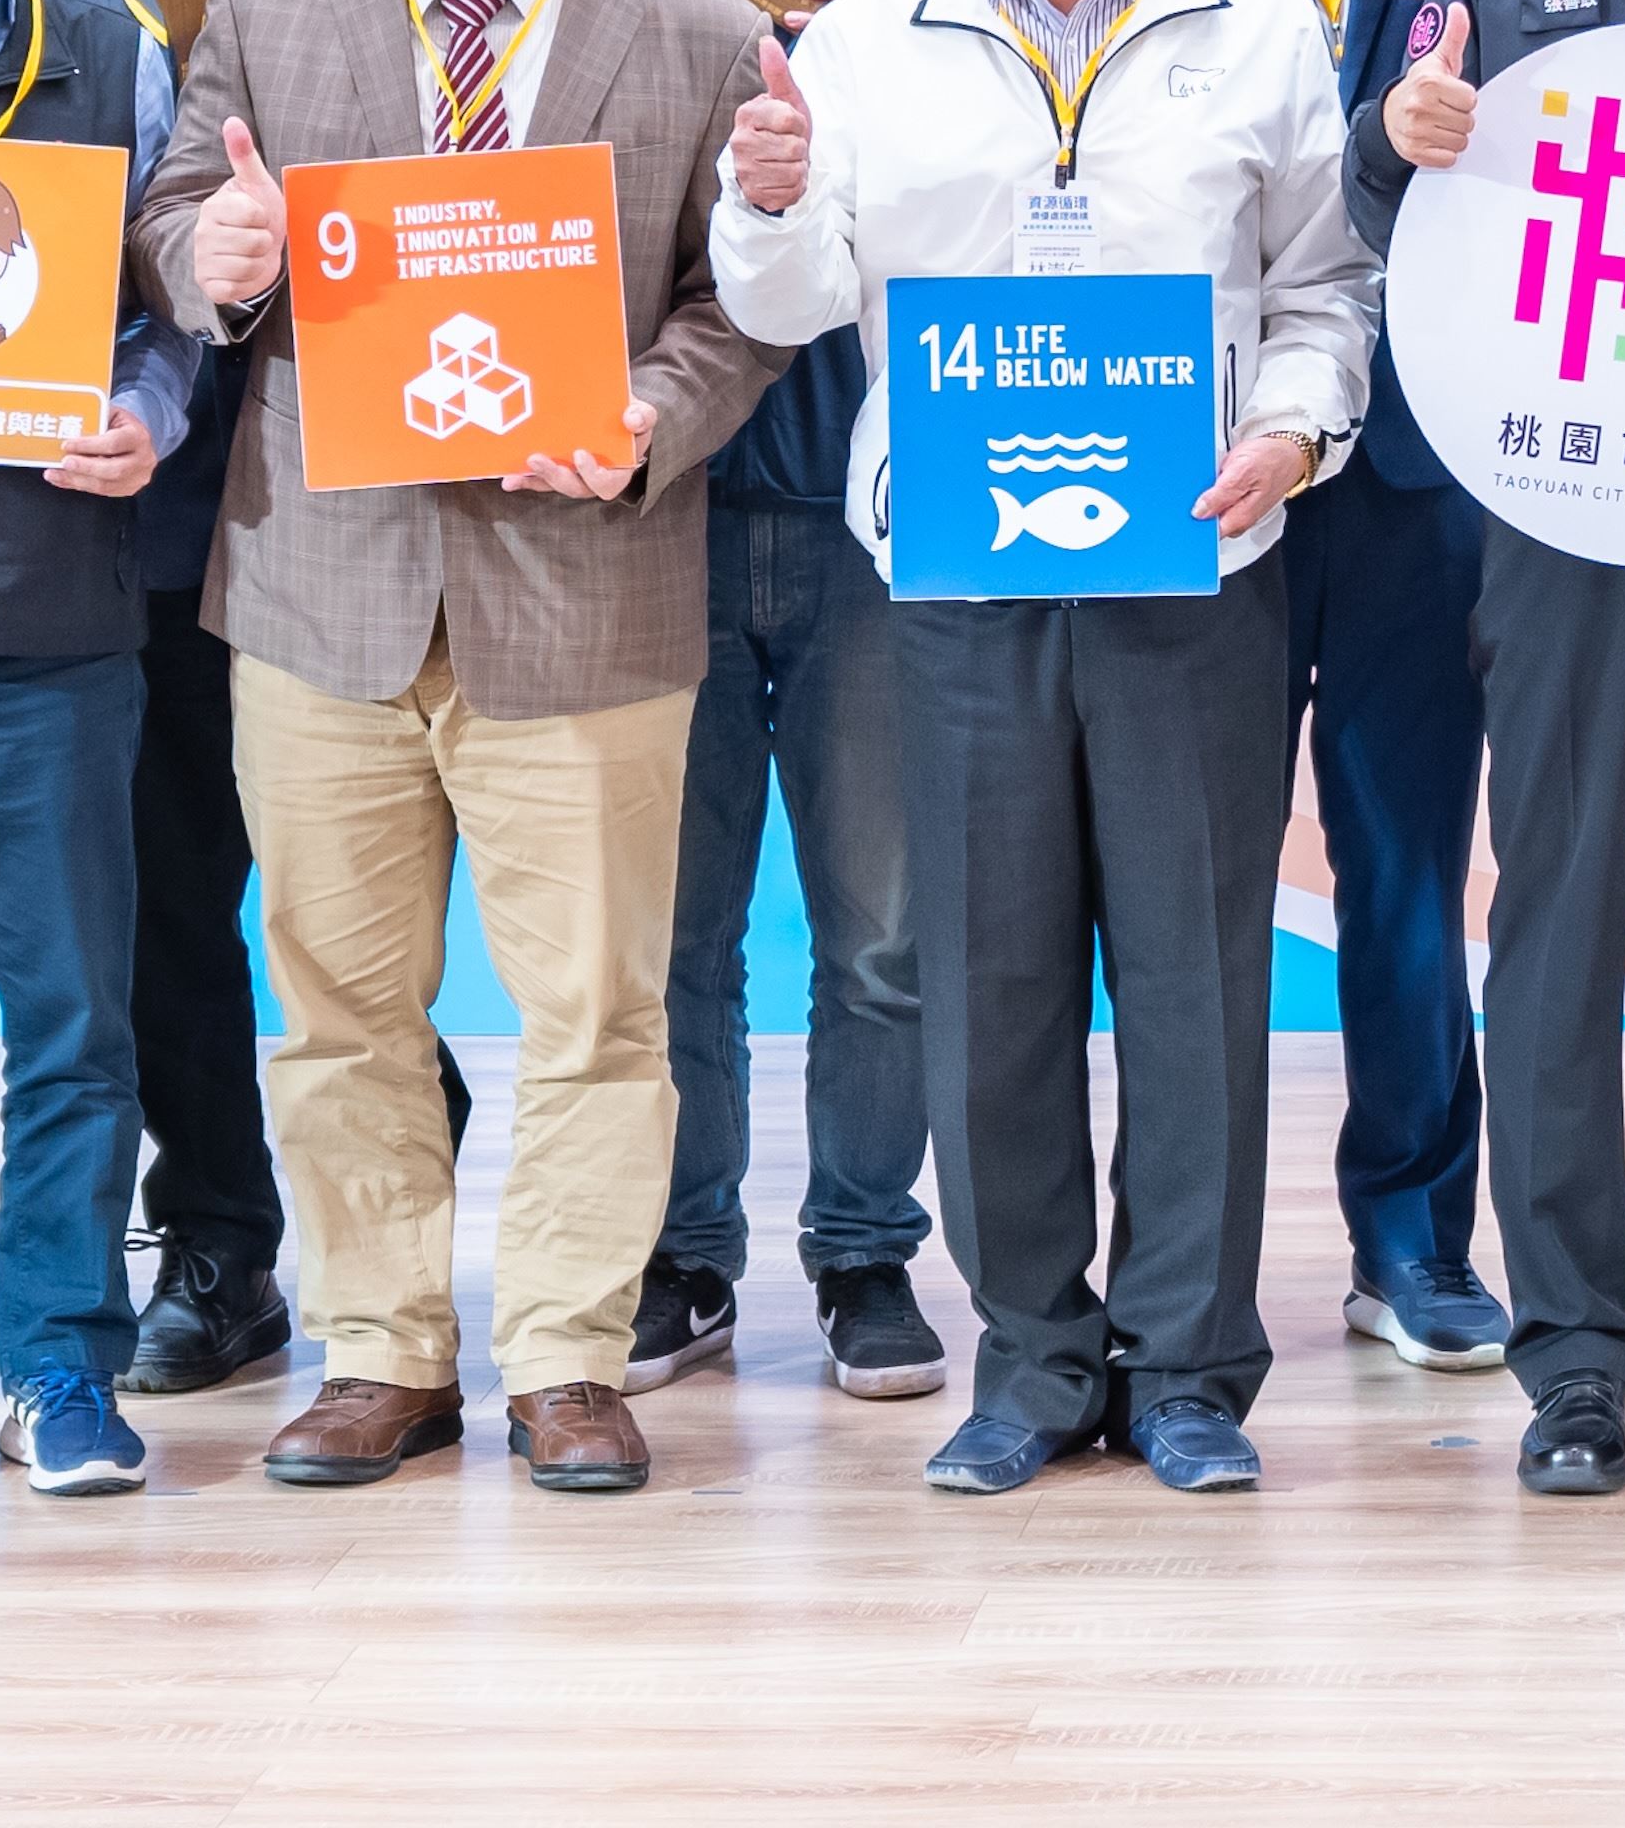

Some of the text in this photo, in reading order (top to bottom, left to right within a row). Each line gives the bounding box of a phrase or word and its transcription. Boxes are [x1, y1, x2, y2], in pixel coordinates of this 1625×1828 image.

[393, 200, 501, 226] INDUSTRY,
[318, 211, 356, 280] 9
[395, 218, 594, 253] INNOVATION AND
[397, 244, 598, 280] INFRASTRUCTURE
[995, 325, 1066, 355] LIFE
[919, 323, 985, 392] 14
[995, 356, 1195, 388] BELOW WATER
[1493, 472, 1584, 498] TAOYUAN
